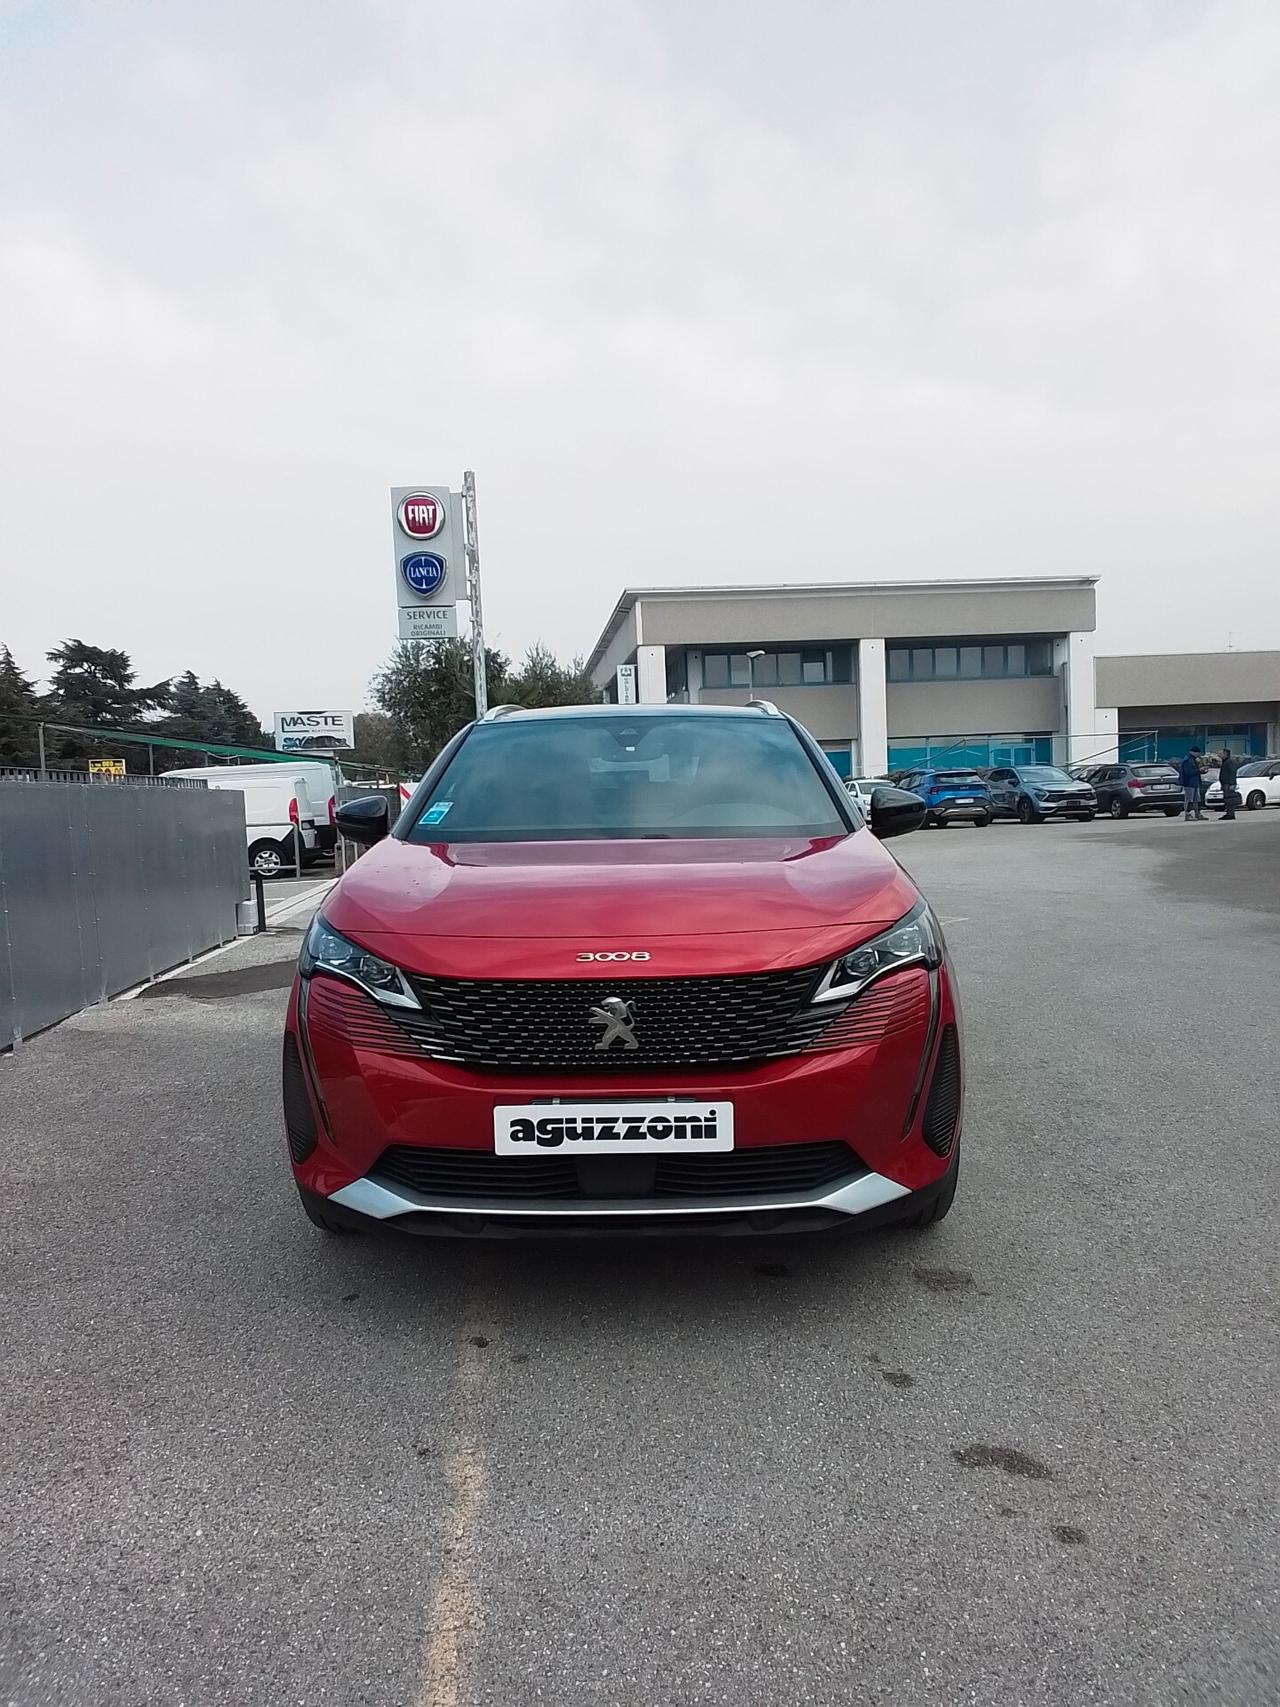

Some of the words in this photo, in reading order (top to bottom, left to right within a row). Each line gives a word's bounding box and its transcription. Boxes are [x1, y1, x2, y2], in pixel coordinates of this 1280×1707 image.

[407, 506, 435, 526] FIAT
[411, 567, 437, 577] LANCIA
[406, 611, 448, 620] SERVICE
[281, 715, 344, 731] MASTE
[576, 951, 652, 962] 3008
[509, 1109, 717, 1147] aguzzoni
